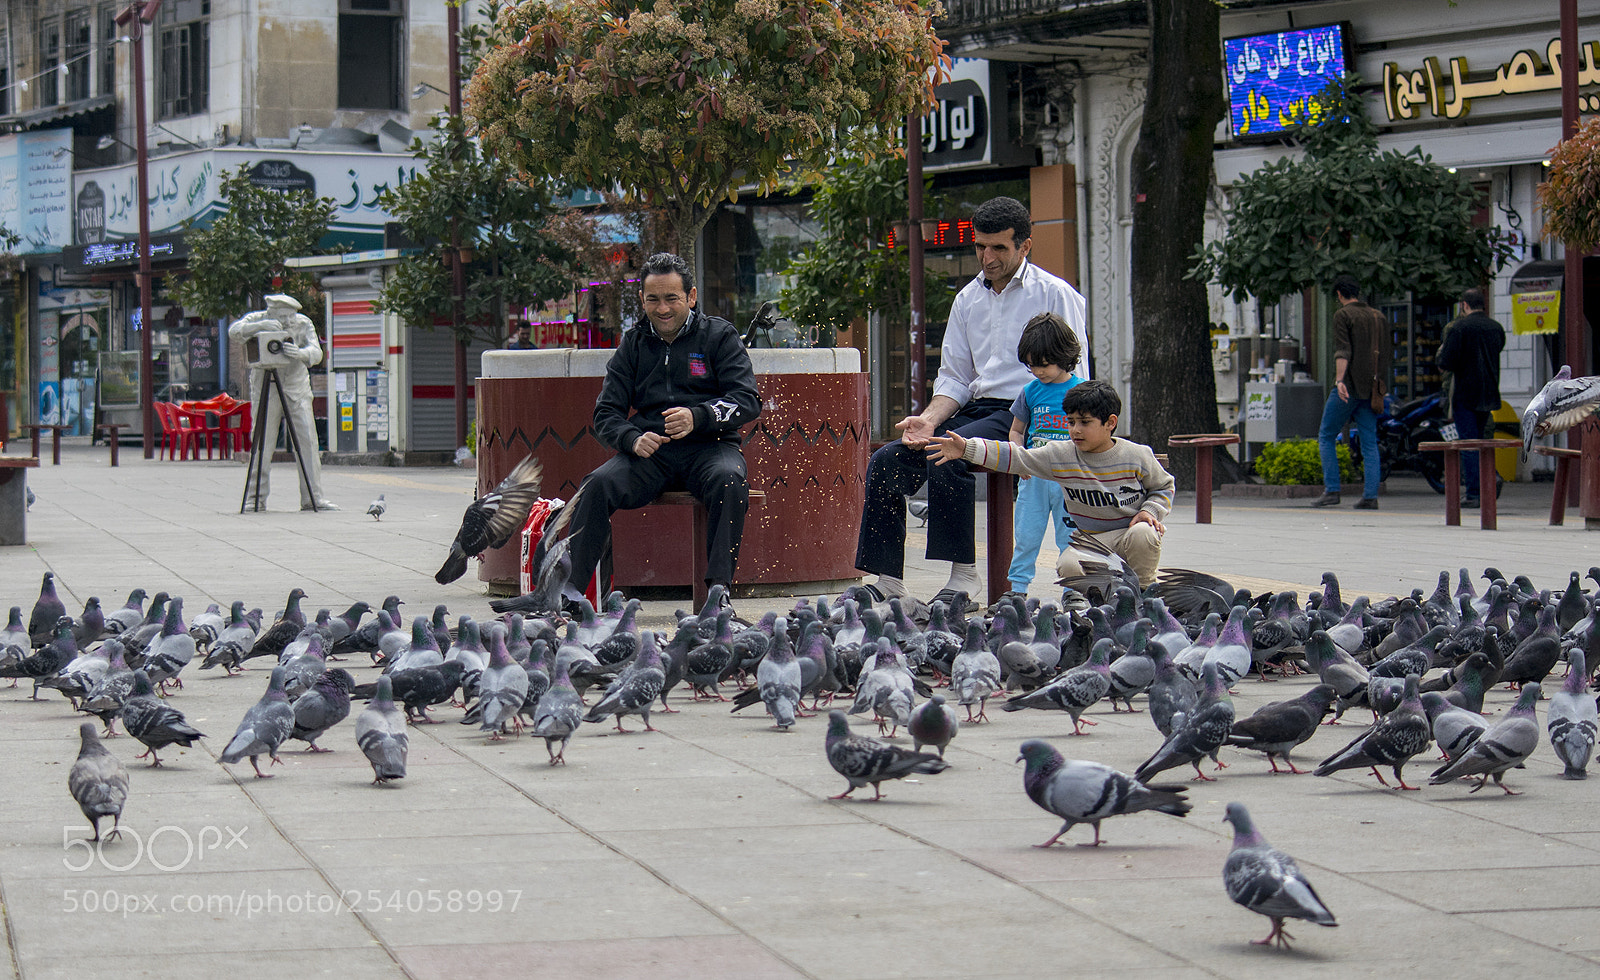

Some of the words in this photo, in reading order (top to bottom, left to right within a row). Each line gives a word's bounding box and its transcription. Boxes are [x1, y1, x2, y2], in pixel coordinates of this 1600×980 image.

[1232, 40, 1261, 84] های
[1266, 32, 1291, 80] نان
[1296, 30, 1336, 76] انواع
[1383, 56, 1439, 122] (عج)
[1444, 37, 1600, 119] یعصر
[1239, 89, 1271, 134] دار
[109, 175, 138, 220] البرز
[147, 164, 181, 217] کباب
[1064, 486, 1120, 509] PUMA
[1119, 493, 1140, 507] PUMA
